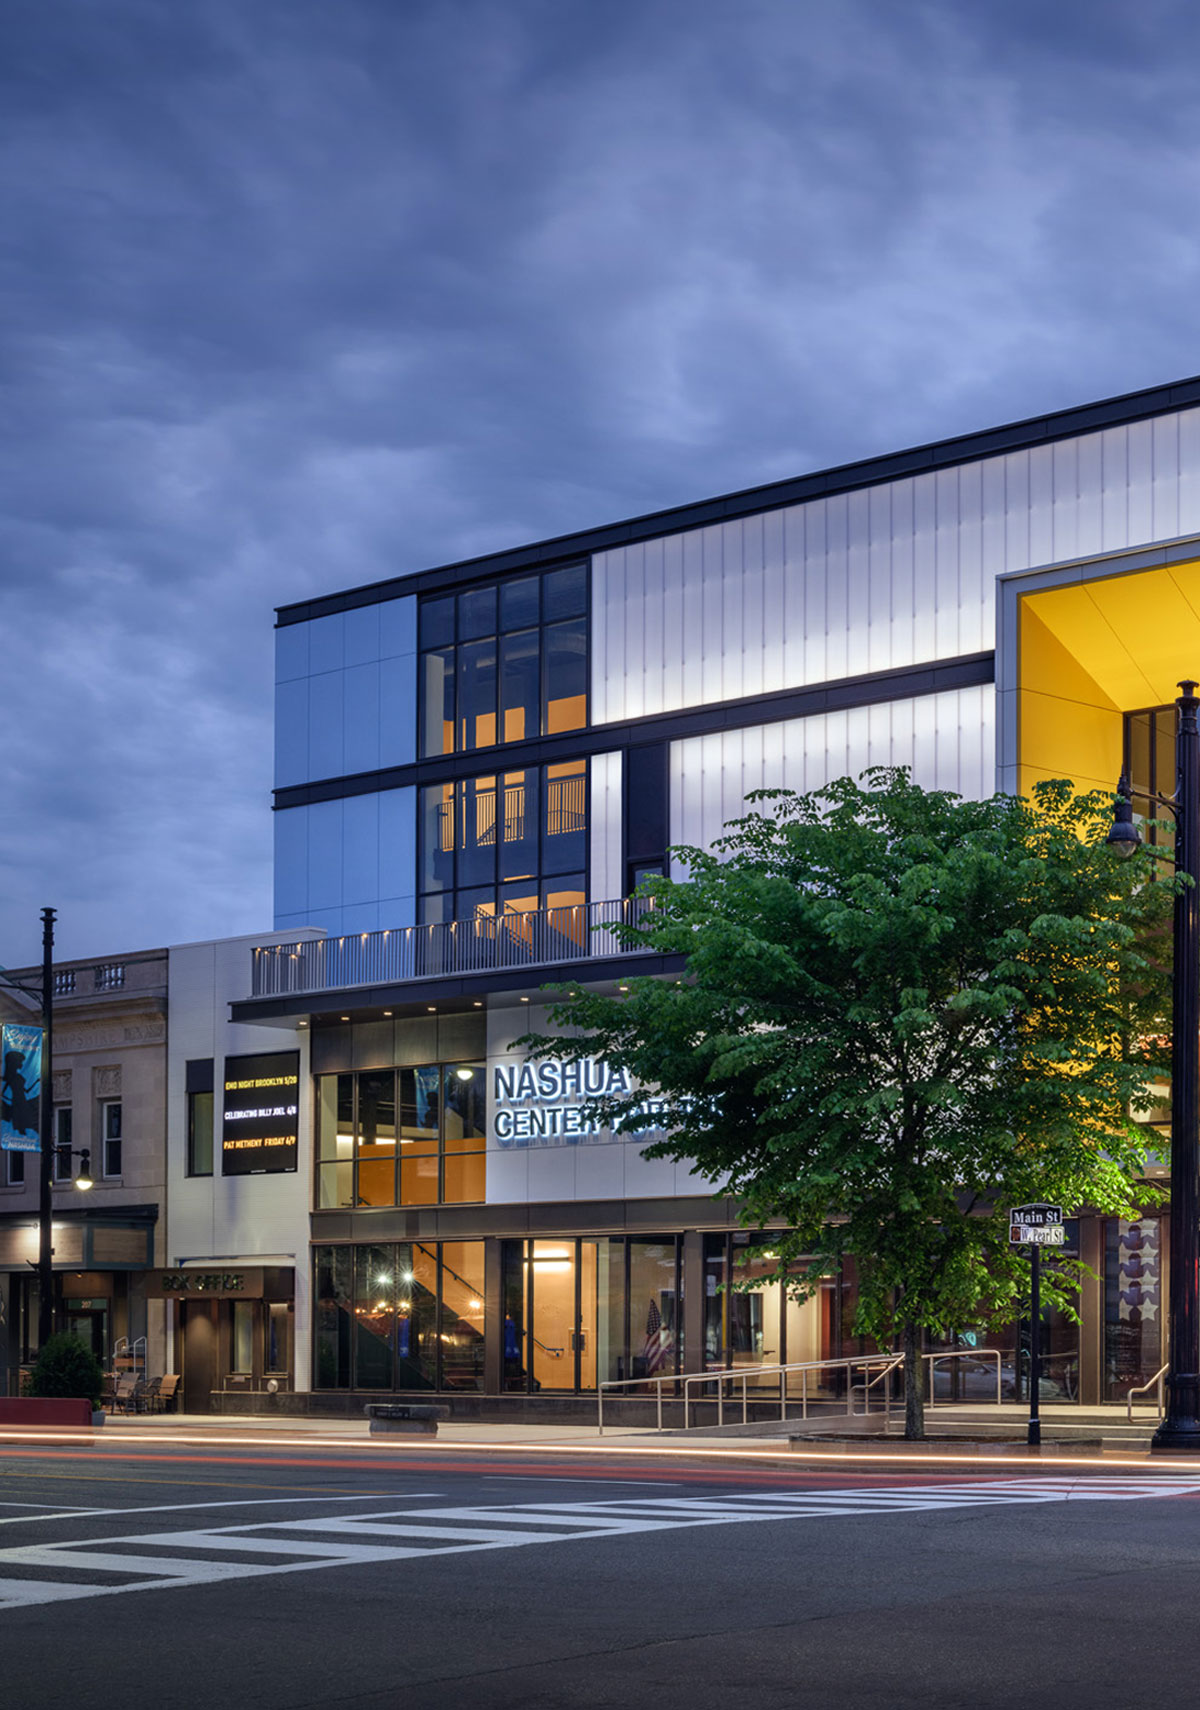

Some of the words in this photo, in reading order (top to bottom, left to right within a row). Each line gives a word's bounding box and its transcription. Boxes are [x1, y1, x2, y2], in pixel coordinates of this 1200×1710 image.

[238, 1080, 255, 1088] NIGHT
[255, 1078, 283, 1087] BROOKLYN
[494, 1059, 629, 1099] NASHUA
[224, 1109, 258, 1120] CELEBRATING
[258, 1109, 272, 1117] BILLY
[272, 1107, 285, 1115] JOEL
[494, 1105, 598, 1138] CENTER
[223, 1141, 235, 1149] PAT
[235, 1139, 262, 1148] METHENY
[264, 1137, 285, 1146] FRIDAY
[1014, 1211, 1043, 1224] Main
[1046, 1210, 1058, 1222] St
[1033, 1228, 1053, 1241] Pearl
[1054, 1229, 1063, 1242] St
[162, 1275, 190, 1290] BOX
[195, 1275, 244, 1291] OFFICE
